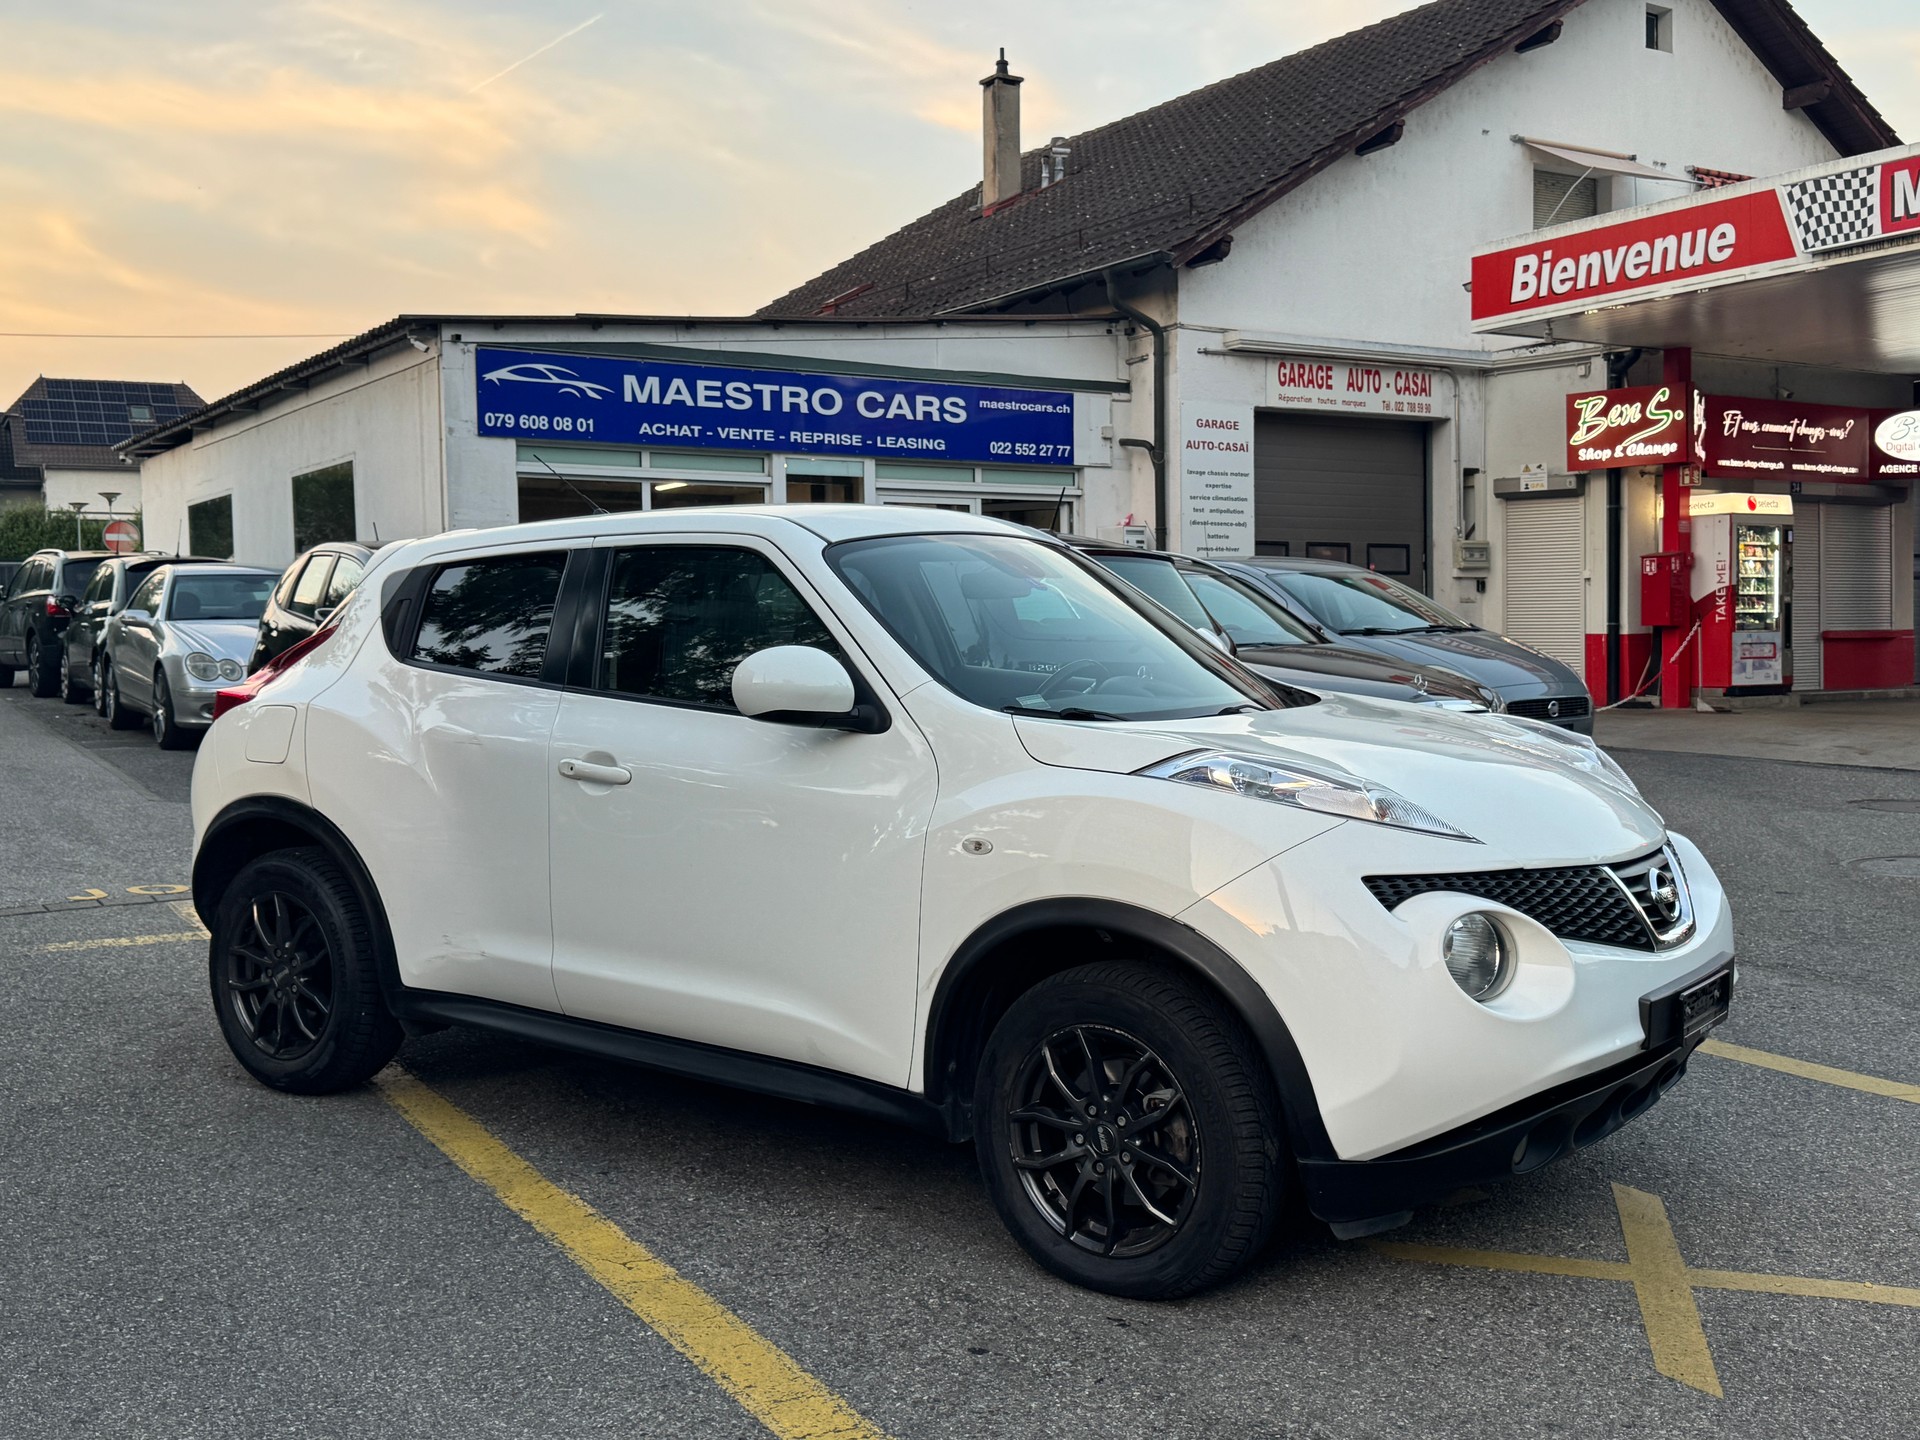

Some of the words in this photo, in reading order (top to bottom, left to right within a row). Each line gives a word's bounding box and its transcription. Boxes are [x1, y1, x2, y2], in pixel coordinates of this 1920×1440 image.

[1510, 223, 1737, 303] Bienvenue
[1278, 361, 1333, 390] GARAGE
[1346, 367, 1381, 394] AUTO
[1394, 371, 1432, 397] CASAI
[623, 374, 843, 416] MAESTRO
[856, 391, 967, 424] CARS
[979, 398, 1071, 414] maestrocars.ch
[1278, 393, 1312, 404] Réparation
[1317, 397, 1337, 406] toutes
[1342, 399, 1366, 408] marques
[484, 412, 515, 428] 079
[519, 414, 549, 430] 608
[553, 416, 573, 431] 08
[576, 418, 594, 433] 01
[1196, 418, 1240, 431] GARAGE
[1570, 395, 1642, 446] Ben
[1723, 410, 1744, 438] Et
[639, 422, 702, 438] ACHAT
[717, 427, 775, 442] VENTE
[790, 431, 862, 446] REPRISE
[876, 436, 946, 451] LEASING
[989, 441, 1011, 455] 022
[1015, 442, 1036, 456] 552
[1039, 444, 1053, 457] 27
[1056, 445, 1071, 458] 77
[1578, 447, 1612, 461] Shop
[1614, 446, 1624, 458] &
[1626, 442, 1678, 457] Change
[1885, 442, 1916, 454] Digital
[1879, 464, 1918, 474] AGENCE
[1758, 500, 1779, 509] selecta
[1716, 559, 1726, 584] ME!
[1715, 587, 1726, 622] TAKE
